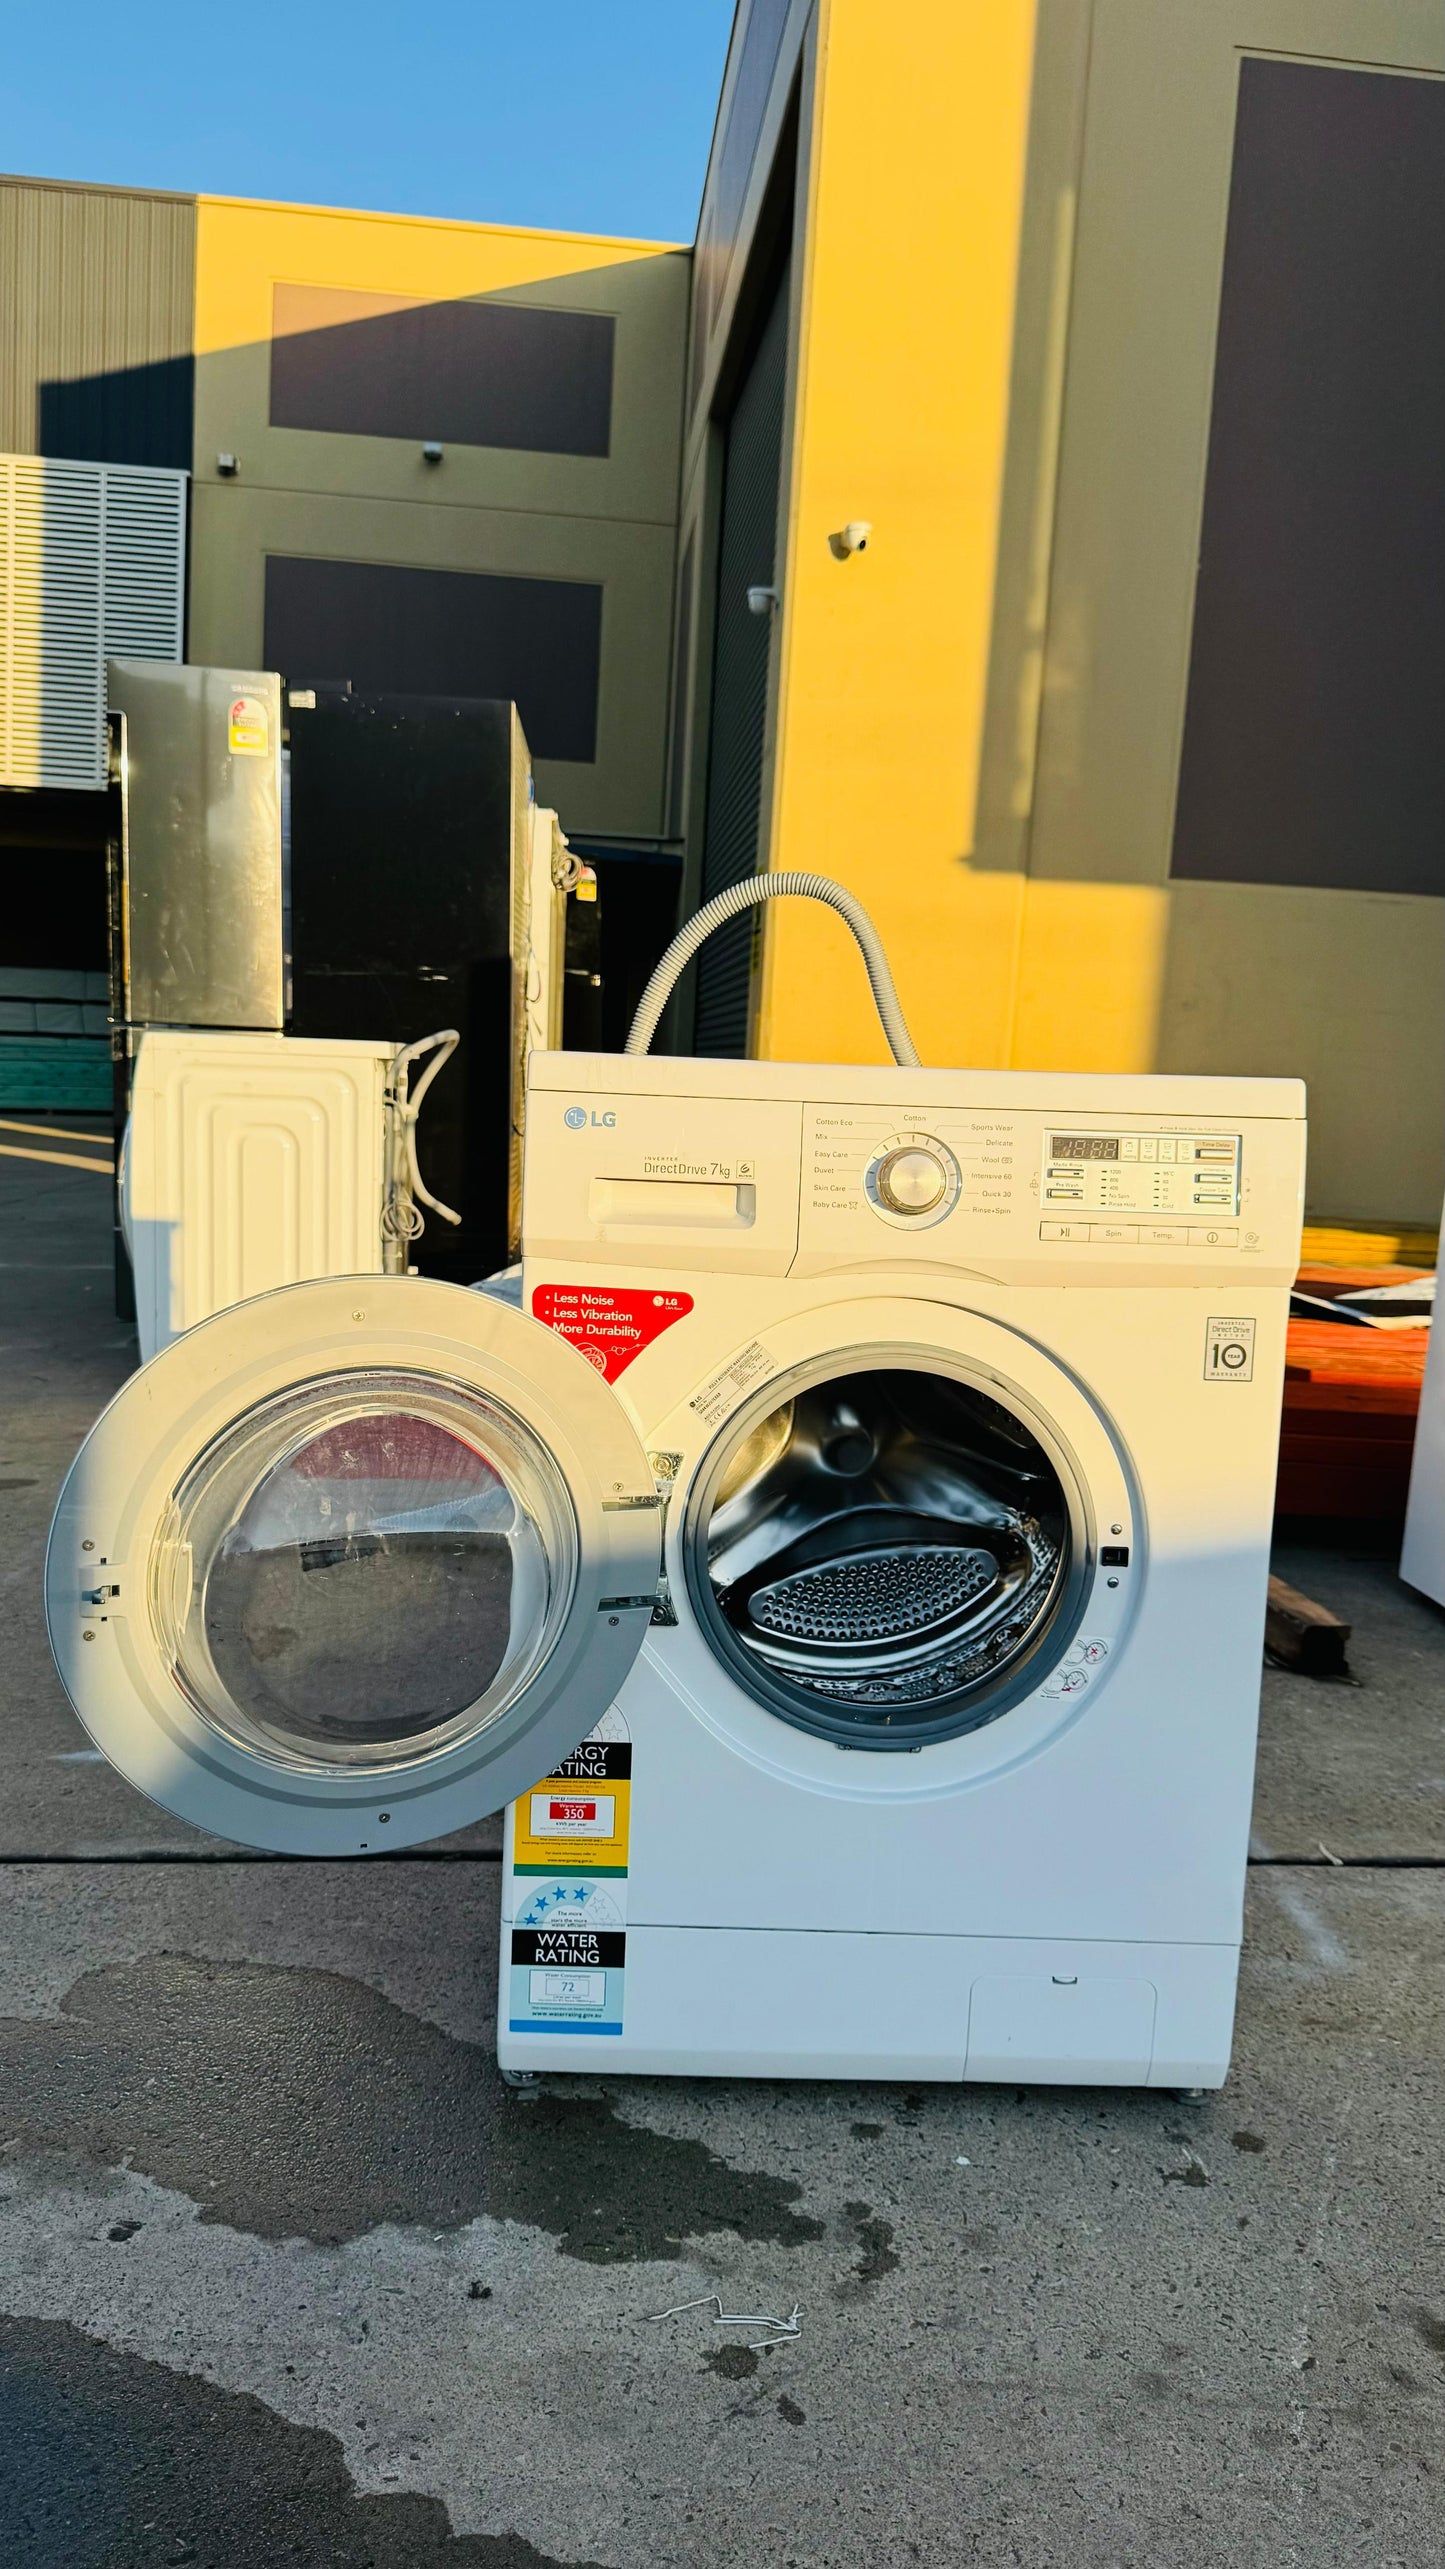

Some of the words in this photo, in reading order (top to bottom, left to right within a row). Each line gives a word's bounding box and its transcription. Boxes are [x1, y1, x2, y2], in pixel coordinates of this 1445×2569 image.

[591, 1111, 616, 1128] LG
[816, 1118, 839, 1126] Cotton
[904, 1114, 926, 1122] Cotton
[995, 1124, 1014, 1132] Wear
[985, 1139, 1014, 1147] Delicate
[814, 1151, 831, 1159] Easy
[832, 1151, 849, 1159] Care
[981, 1156, 1000, 1164] Wool
[814, 1167, 835, 1175] Duvet
[982, 1190, 1002, 1198] Quick
[1003, 1190, 1012, 1198] 30
[812, 1201, 831, 1209] Baby
[832, 1201, 847, 1209] Care
[1105, 1229, 1122, 1239] Spin
[1152, 1231, 1175, 1240] Temp.
[554, 1292, 579, 1304] Less
[581, 1294, 615, 1306] Noise
[665, 1297, 678, 1306] LG
[553, 1307, 578, 1319] Less
[580, 1308, 633, 1322] Vibration
[552, 1322, 584, 1335] More
[586, 1324, 642, 1340] Durability
[1212, 1343, 1247, 1369] 10
[549, 1762, 607, 1776] ATING
[563, 1808, 585, 1820] 350
[537, 1933, 599, 1948] WATER
[535, 1949, 600, 1964] RATING
[561, 1981, 575, 1992] 72
